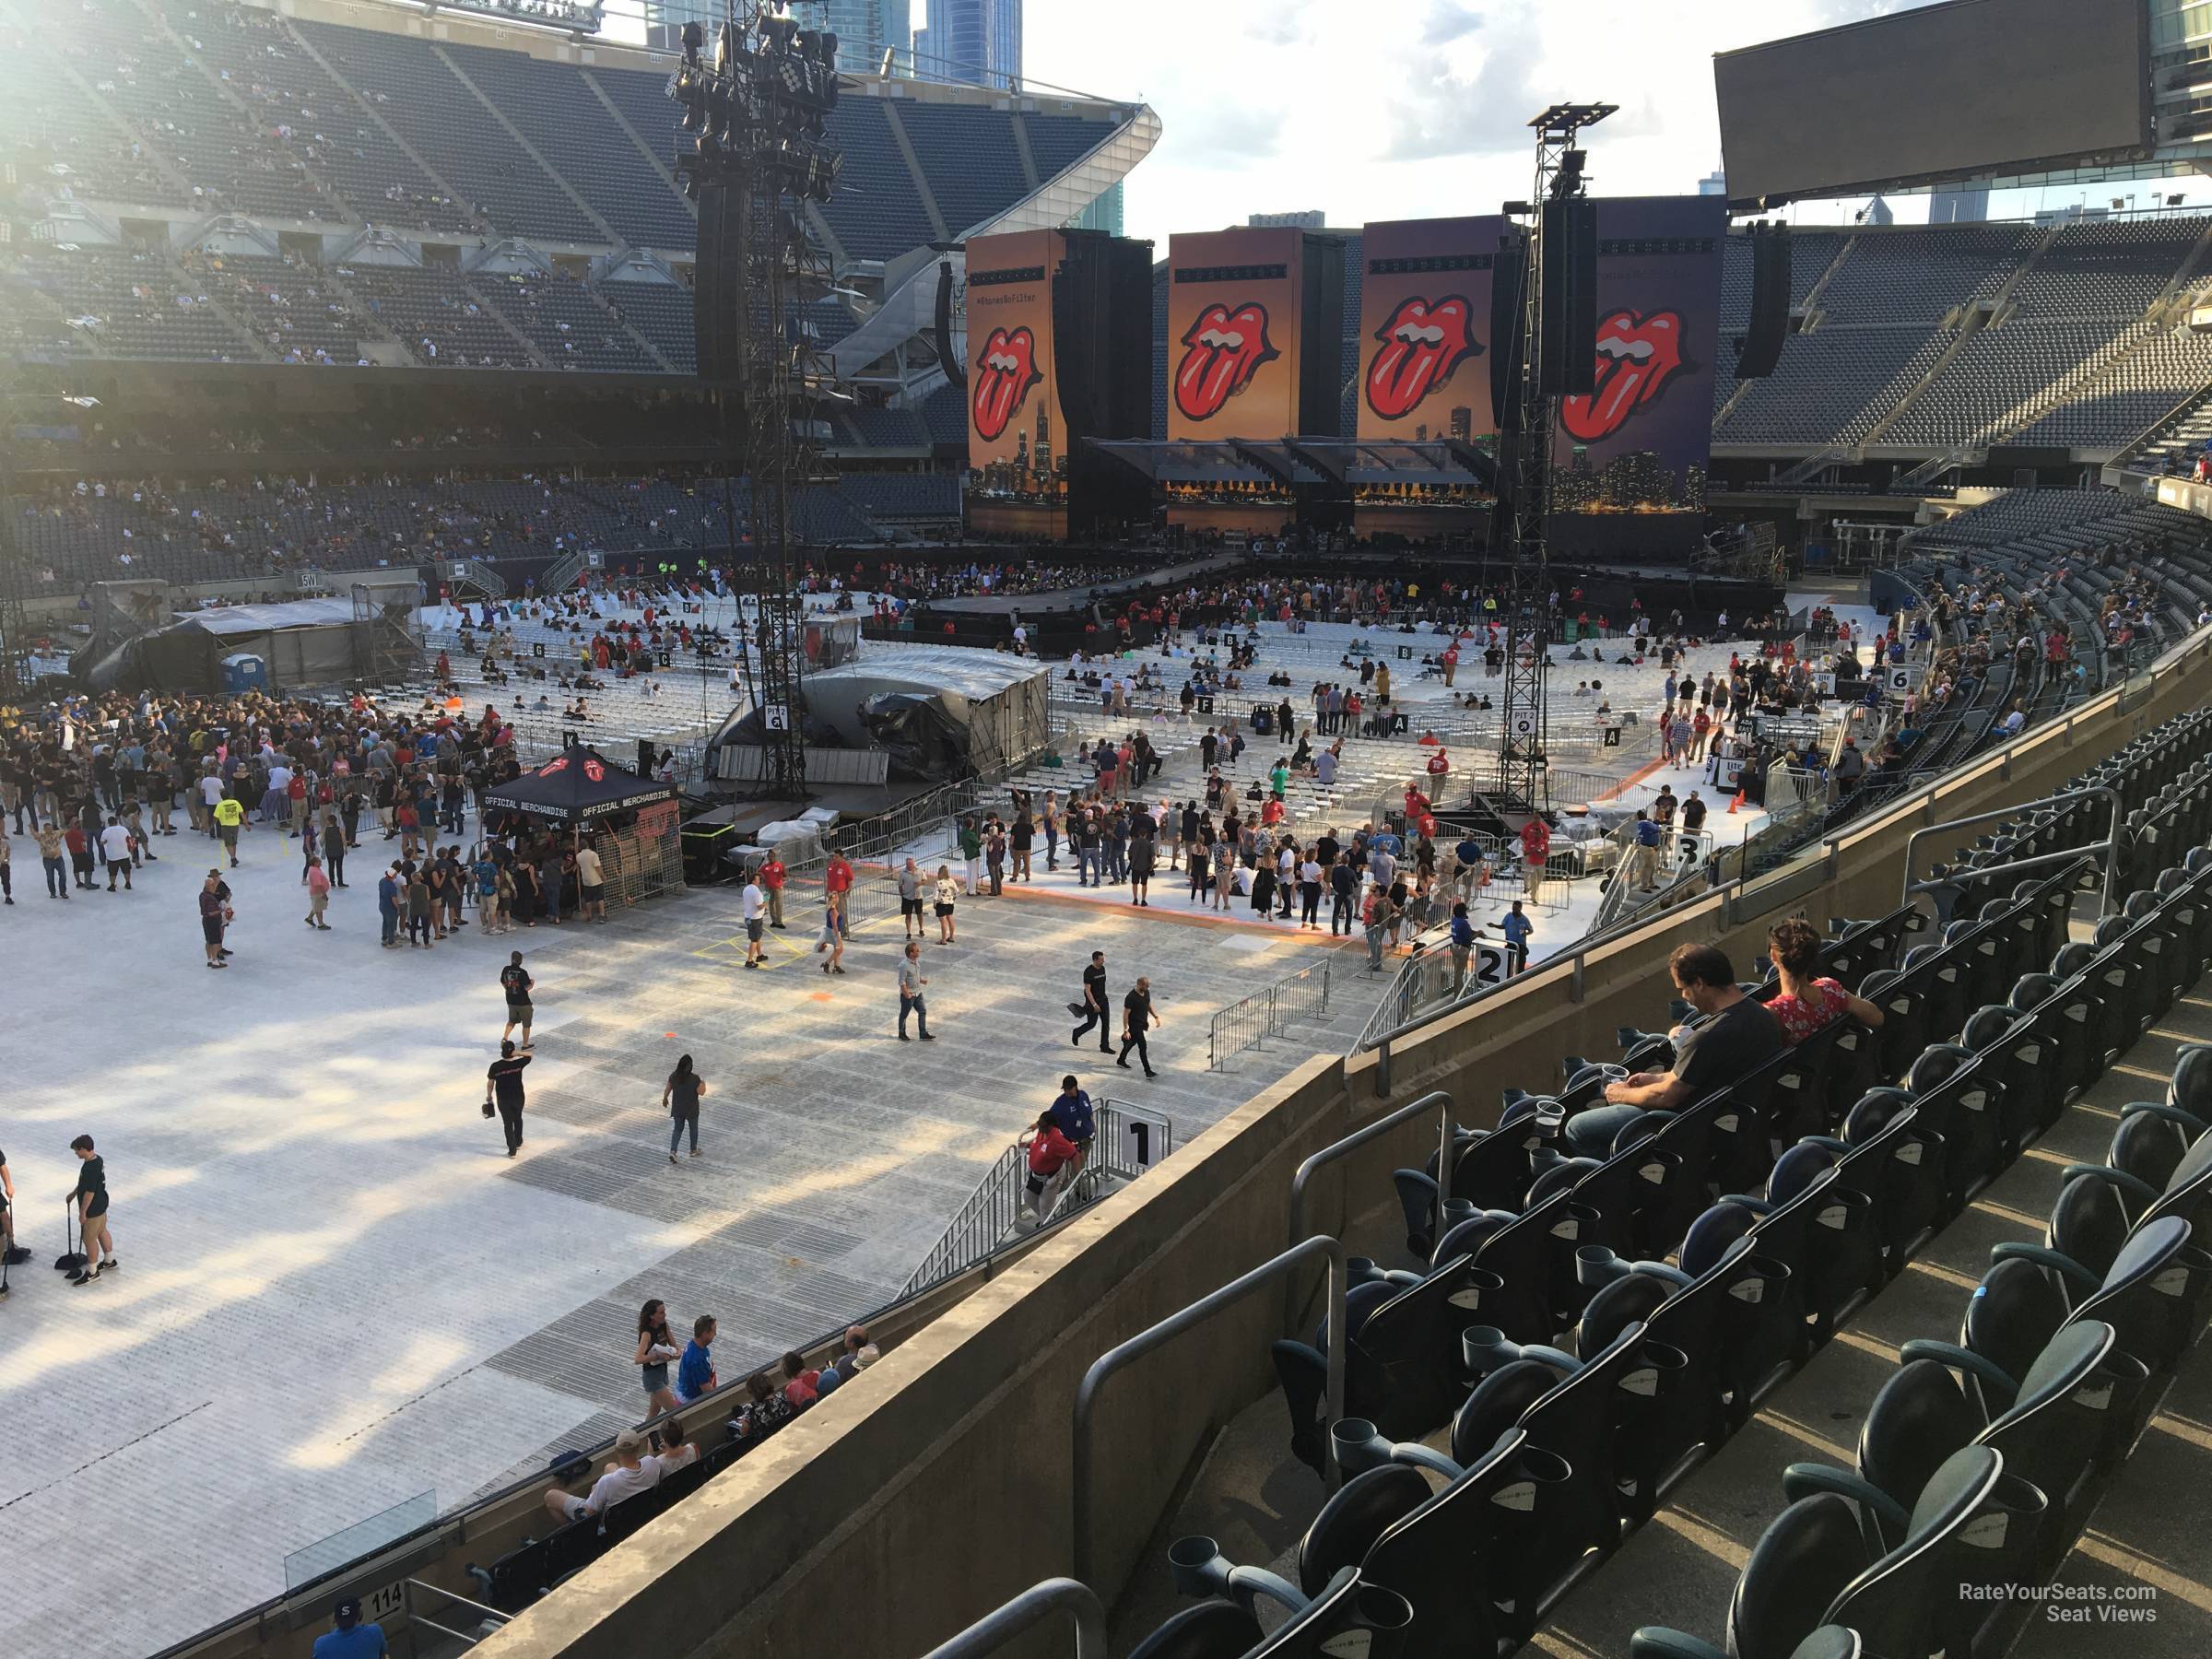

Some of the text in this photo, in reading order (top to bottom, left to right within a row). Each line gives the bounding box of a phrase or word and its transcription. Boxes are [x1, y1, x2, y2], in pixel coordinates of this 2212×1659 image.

[302, 575, 315, 587] 5W
[1228, 636, 1233, 644] B
[536, 645, 542, 655] G
[1402, 649, 1408, 657] B
[662, 654, 668, 665] C
[1894, 672, 1907, 688] 6
[1202, 700, 1208, 710] F
[1514, 712, 1535, 720] PIT 2
[1395, 716, 1404, 729] A
[567, 735, 573, 747] K
[1607, 731, 1616, 744] A
[1726, 761, 1742, 771] Lite
[485, 796, 569, 818] OFFICIAL MERCHANDISE
[582, 789, 671, 818] OFFICIAL MERCHANDISE
[1678, 838, 1698, 865] 3
[1478, 949, 1501, 983] 2
[1130, 1122, 1148, 1166] 1
[372, 1583, 401, 1613] 114
[341, 1606, 350, 1616] S
